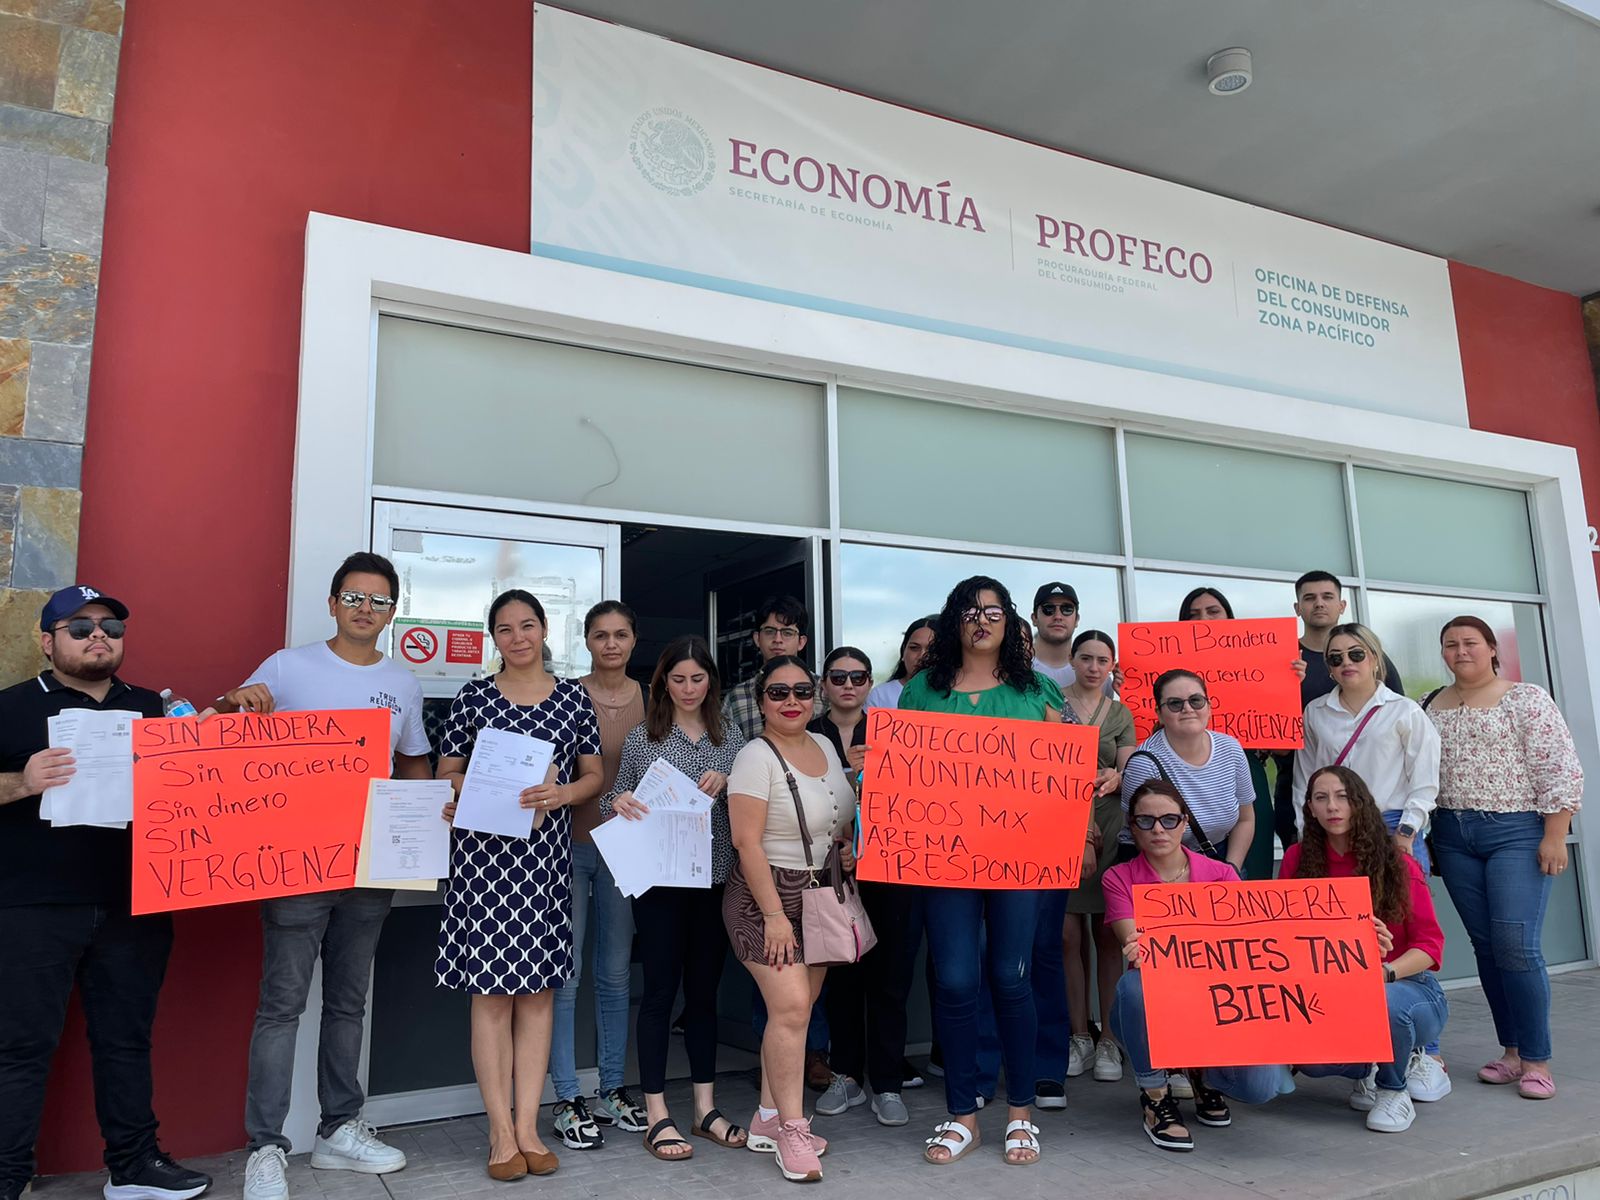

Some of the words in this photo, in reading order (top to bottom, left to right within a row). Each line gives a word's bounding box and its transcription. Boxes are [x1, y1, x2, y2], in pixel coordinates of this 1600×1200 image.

[729, 138, 986, 232] ECONOMÍA
[728, 186, 806, 212] SECRETARÍA
[811, 205, 827, 217] DE
[831, 210, 894, 231] ECONOMÍA
[1035, 214, 1213, 284] PROFECO
[1037, 258, 1114, 281] PROCURADURÍA
[1117, 275, 1159, 291] FEDERAL
[1038, 269, 1055, 279] DEL
[1058, 272, 1125, 294] CONSUMIDOR
[1254, 268, 1318, 295] OFICINA
[1322, 284, 1342, 301] DE
[1345, 289, 1410, 318] DEFENSA
[1257, 288, 1287, 309] DEL
[1291, 297, 1391, 333] CONSUMIDOR
[1258, 310, 1303, 332] ZONA
[1307, 322, 1375, 348] PACÍFICO
[78, 586, 100, 600] LA
[1131, 626, 1182, 656] Sin
[1192, 623, 1278, 652] Bandera
[378, 691, 397, 704] TRUE
[139, 721, 200, 748] SIN
[218, 714, 347, 746] BANDERA
[871, 711, 1017, 763] PROTECCIÓN
[1030, 738, 1085, 766] CIVIL
[1212, 710, 1304, 743] ERGÜENZAS
[159, 761, 224, 787] Sin
[877, 749, 1096, 803] AYUNTAMIENTO
[147, 800, 199, 825] Sin
[208, 791, 288, 819] dinero
[868, 791, 963, 827] EKOOS
[979, 803, 1029, 834] MX
[145, 825, 214, 854] SIN
[867, 825, 969, 855] AREMA
[880, 849, 1080, 888] ¡RESPONDAN!
[1142, 888, 1197, 919] SIN
[1203, 883, 1347, 922] BANDERA
[1294, 935, 1369, 974] TAN
